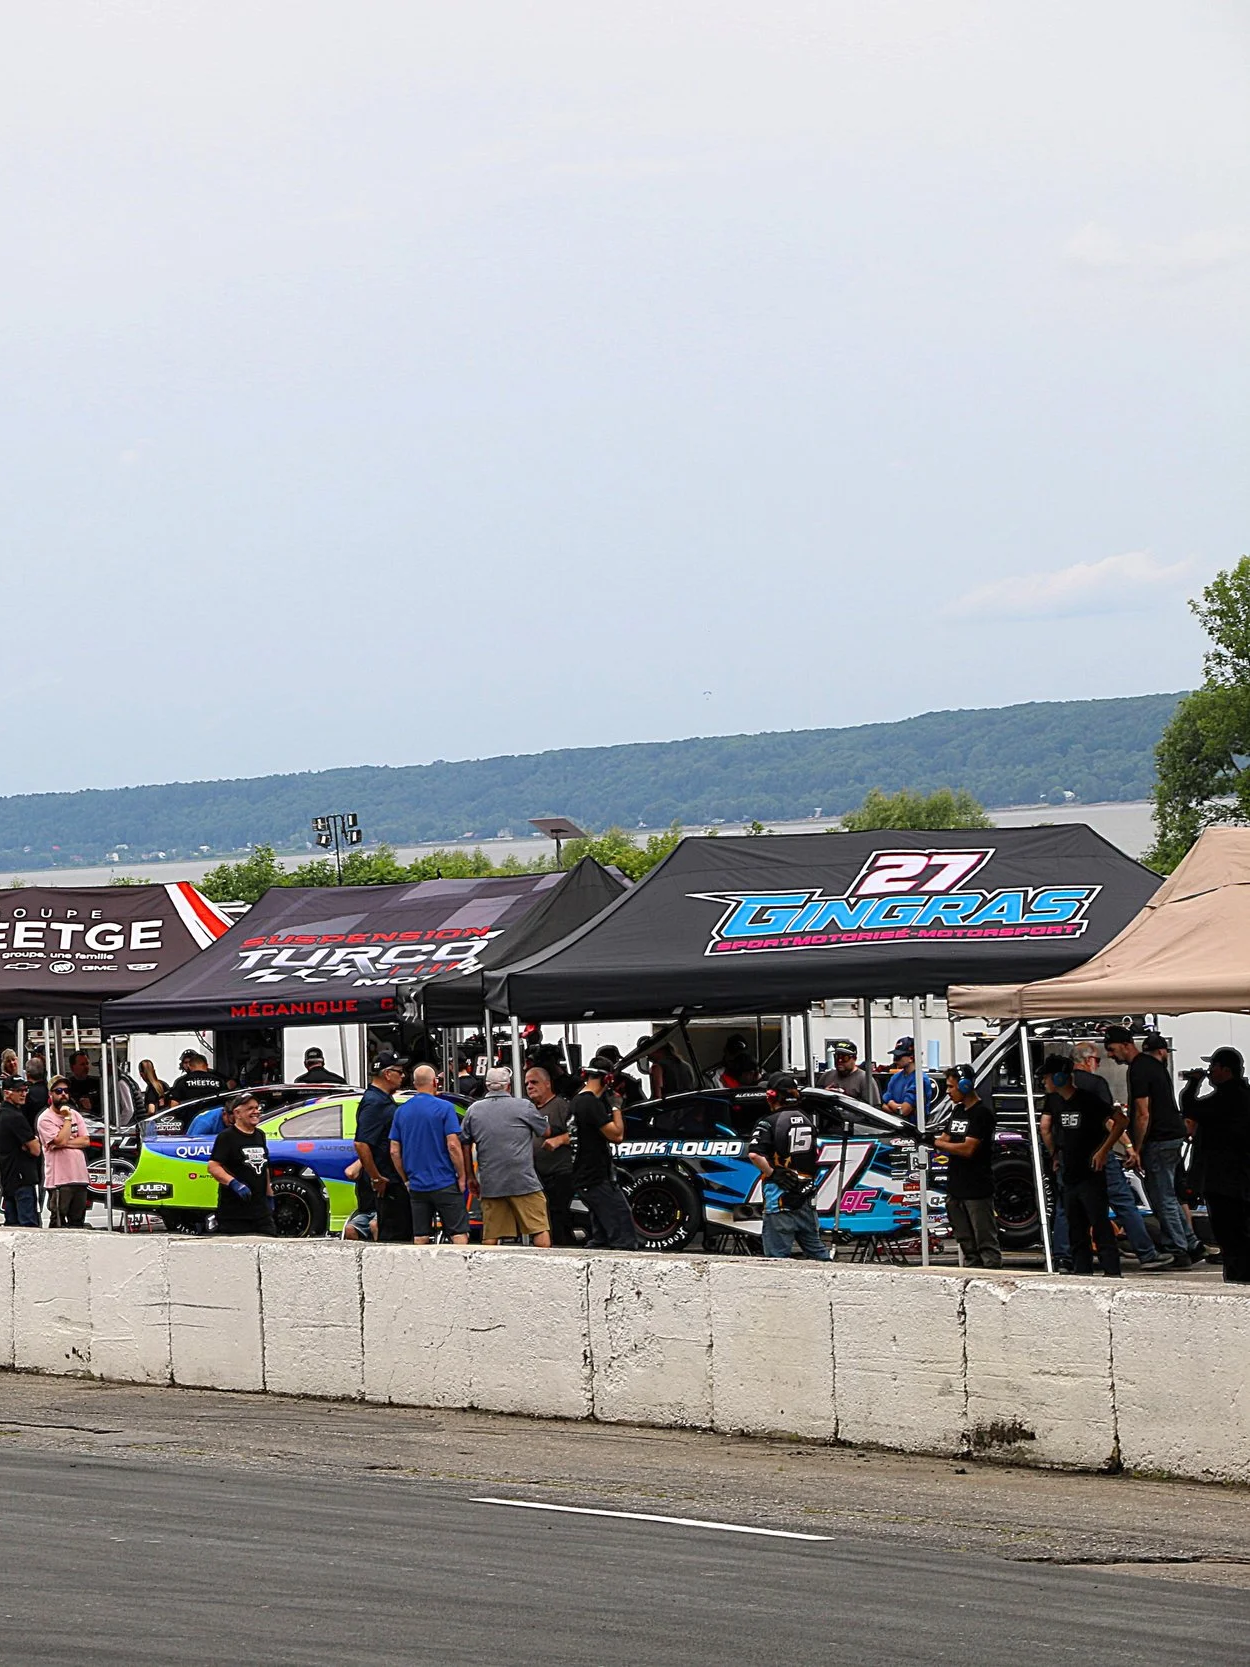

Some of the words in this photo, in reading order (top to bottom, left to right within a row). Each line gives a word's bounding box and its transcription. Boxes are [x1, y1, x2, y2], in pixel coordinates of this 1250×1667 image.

[858, 853, 983, 895] 27
[723, 890, 1087, 937] GINGRAS
[240, 926, 492, 948] SUSPENSION
[233, 938, 490, 975] TURCO
[231, 1000, 358, 1018] MÉCANIQUE
[186, 1079, 220, 1088] THEETGE
[671, 1140, 742, 1157] LOURD
[789, 1126, 812, 1153] 15
[269, 1182, 306, 1196] oosier
[624, 1174, 666, 1196] Hoosier
[839, 1190, 878, 1212] QC
[644, 1228, 689, 1250] Hoosier
